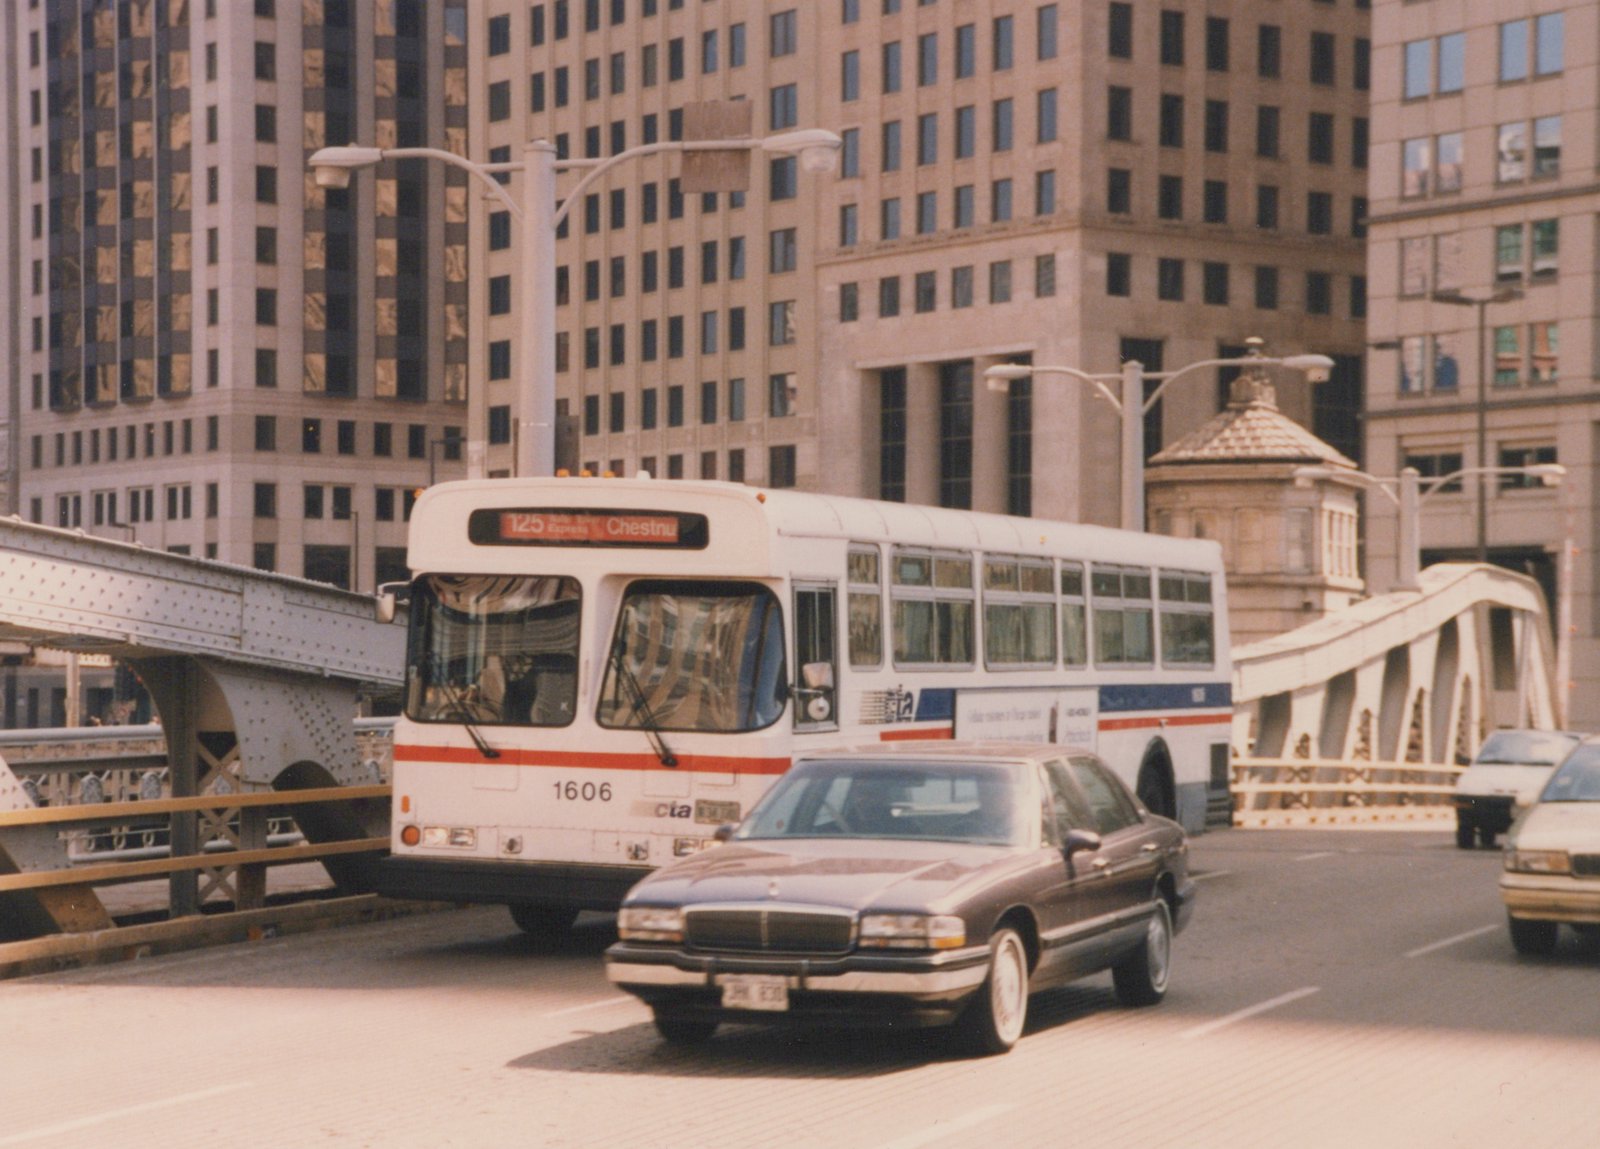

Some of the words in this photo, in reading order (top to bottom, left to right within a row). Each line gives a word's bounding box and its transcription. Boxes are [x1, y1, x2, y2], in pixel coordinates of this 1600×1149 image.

[509, 513, 544, 534] 125
[553, 781, 612, 802] 1606
[655, 801, 692, 819] cta
